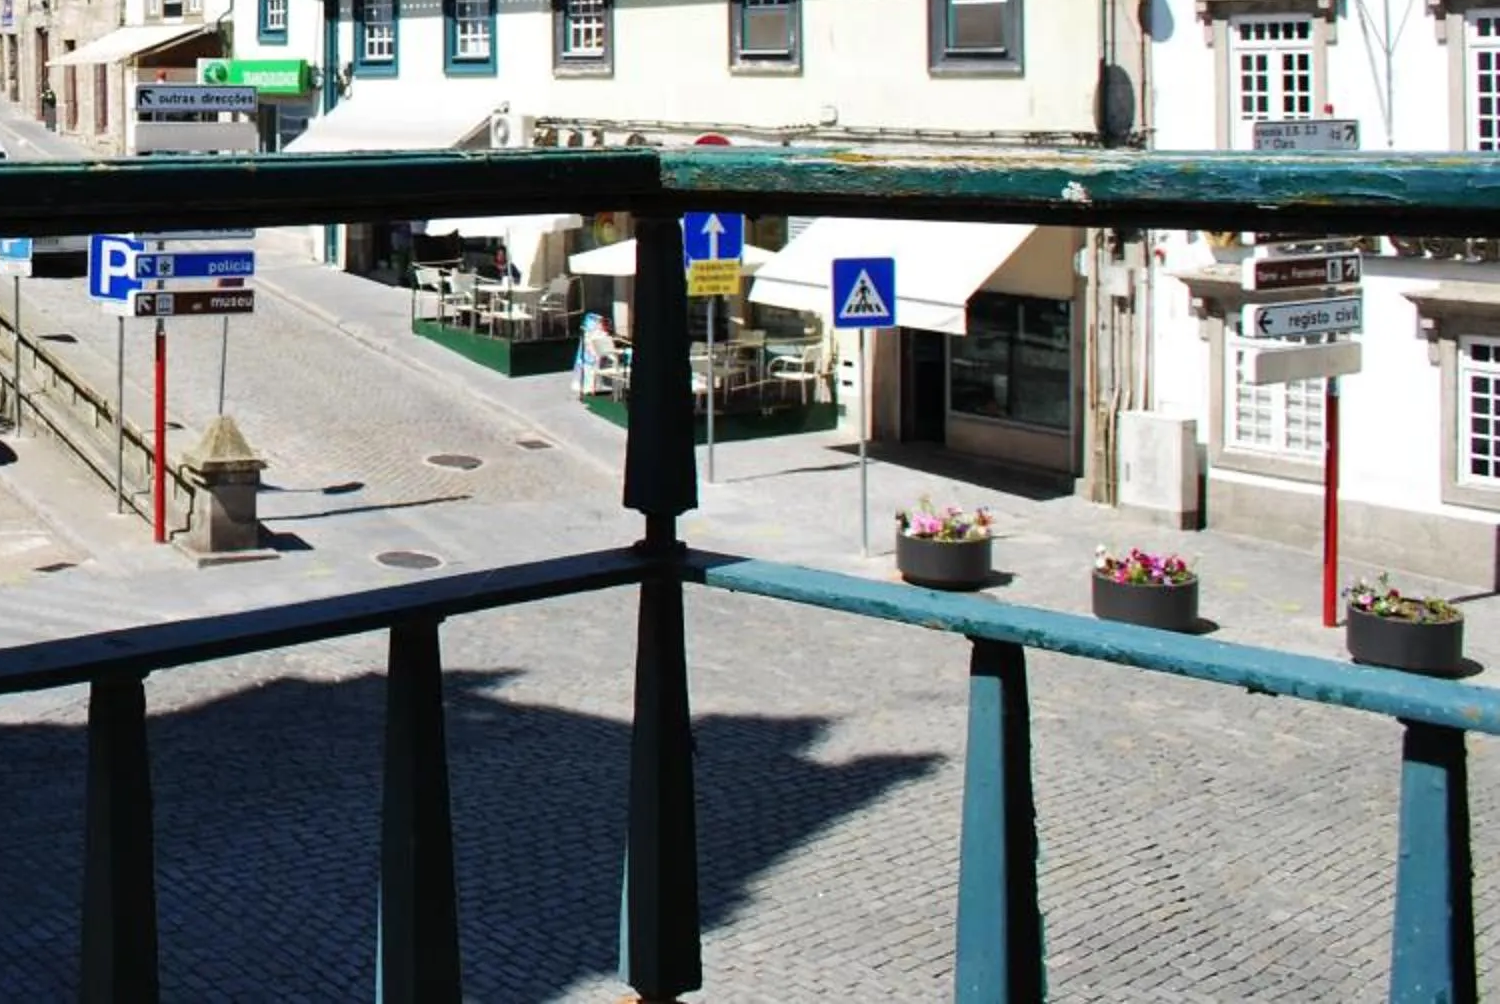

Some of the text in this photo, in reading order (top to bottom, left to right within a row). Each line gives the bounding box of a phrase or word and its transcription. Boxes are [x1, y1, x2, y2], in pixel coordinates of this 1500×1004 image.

[158, 90, 253, 107] outras direcções
[100, 238, 136, 294] P
[210, 296, 252, 308] museu
[1288, 305, 1359, 329] registo civil
